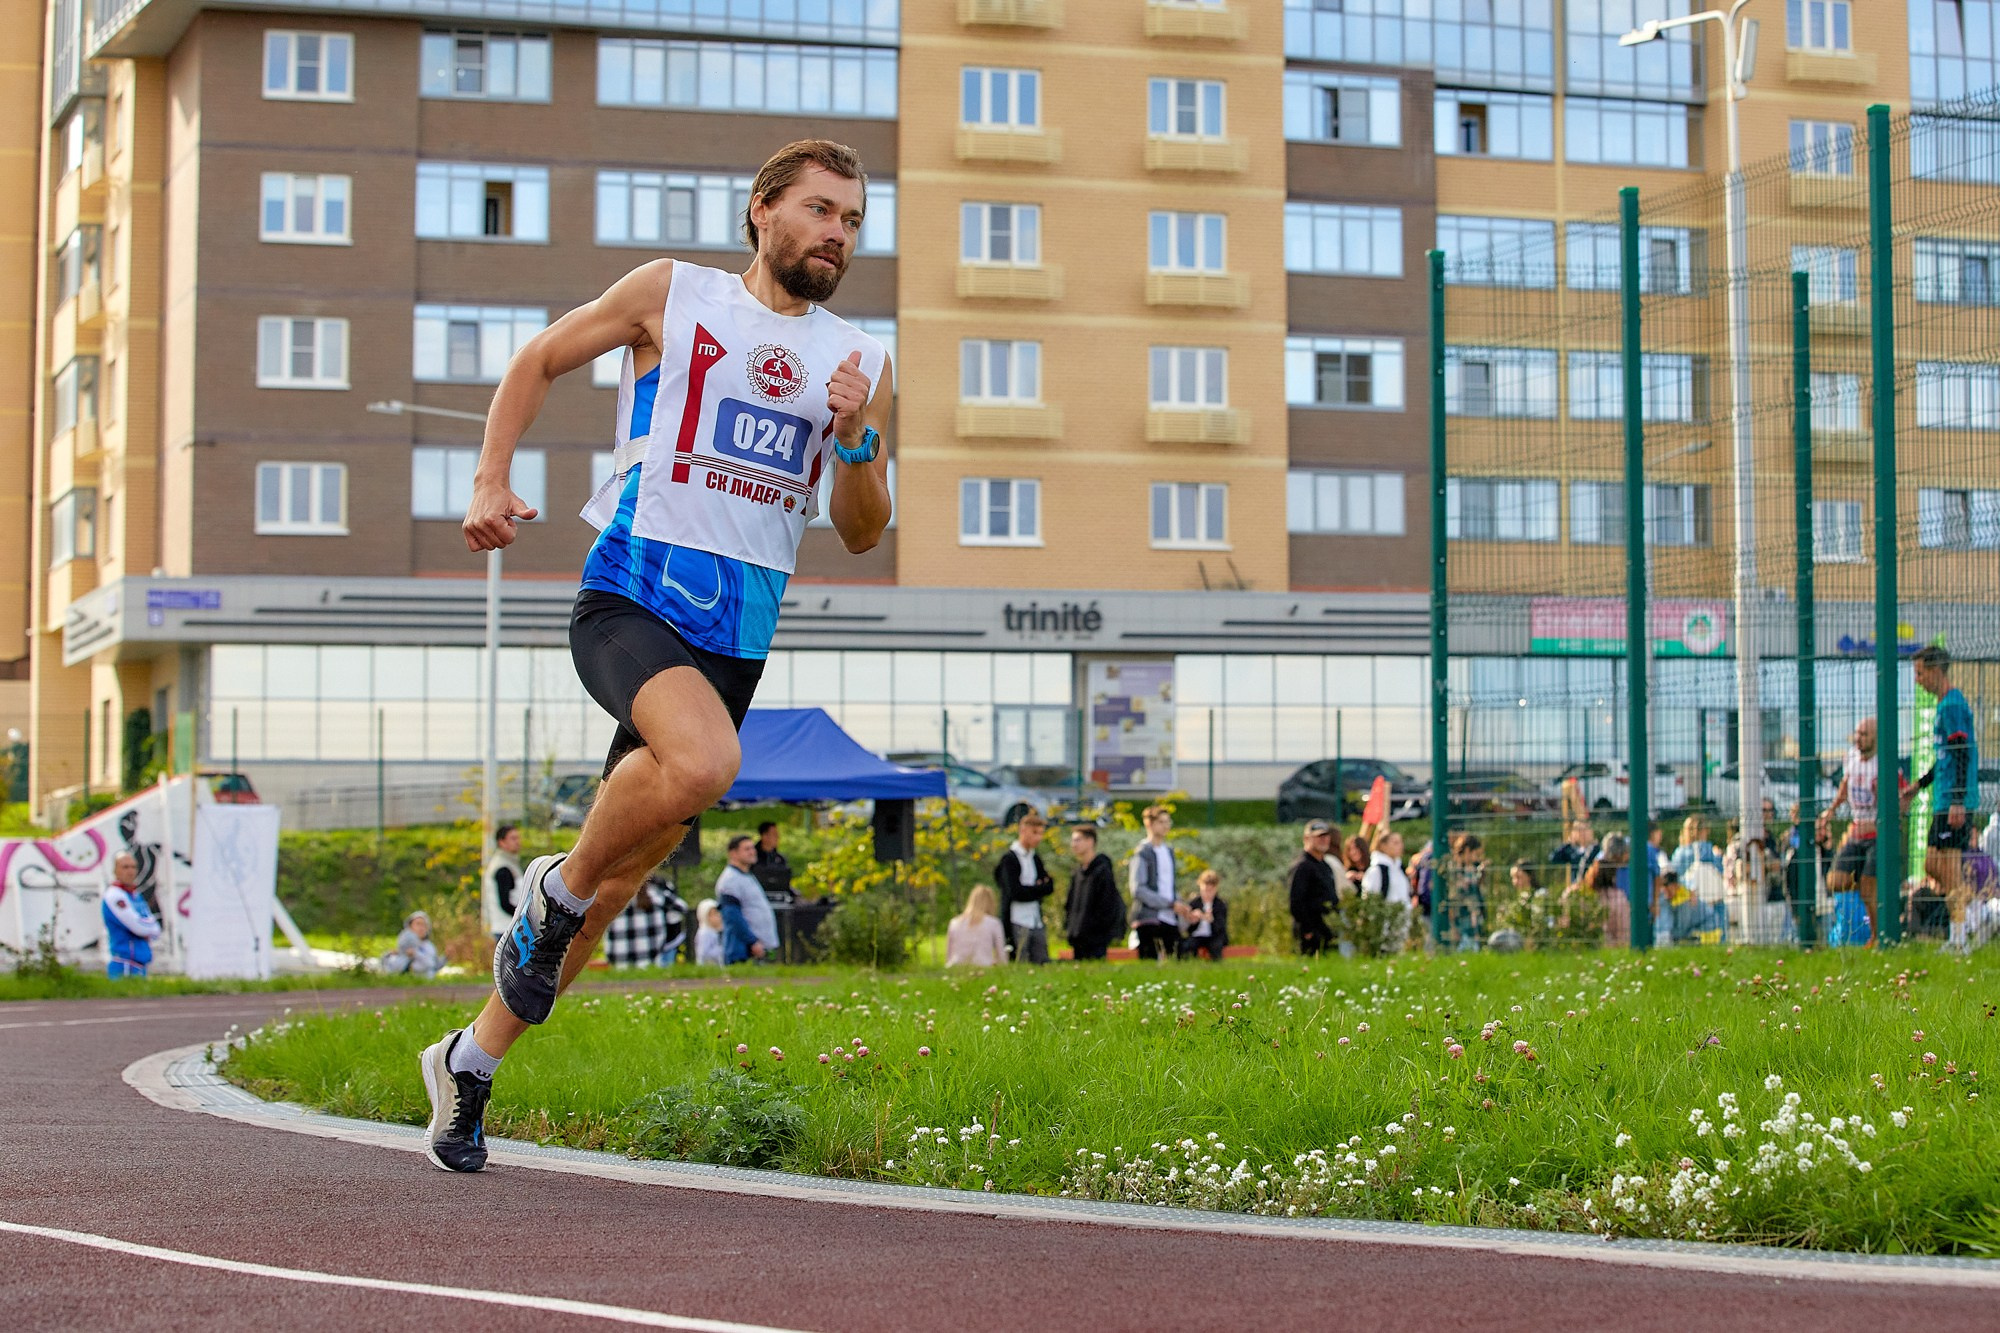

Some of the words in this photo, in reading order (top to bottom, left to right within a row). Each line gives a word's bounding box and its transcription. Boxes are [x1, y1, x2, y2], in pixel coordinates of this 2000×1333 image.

[698, 343, 718, 357] ГТО
[769, 376, 785, 386] ГТО
[733, 412, 797, 462] 024
[705, 471, 729, 492] СК
[729, 477, 782, 506] ЛИДЕР
[1004, 601, 1102, 632] trinité
